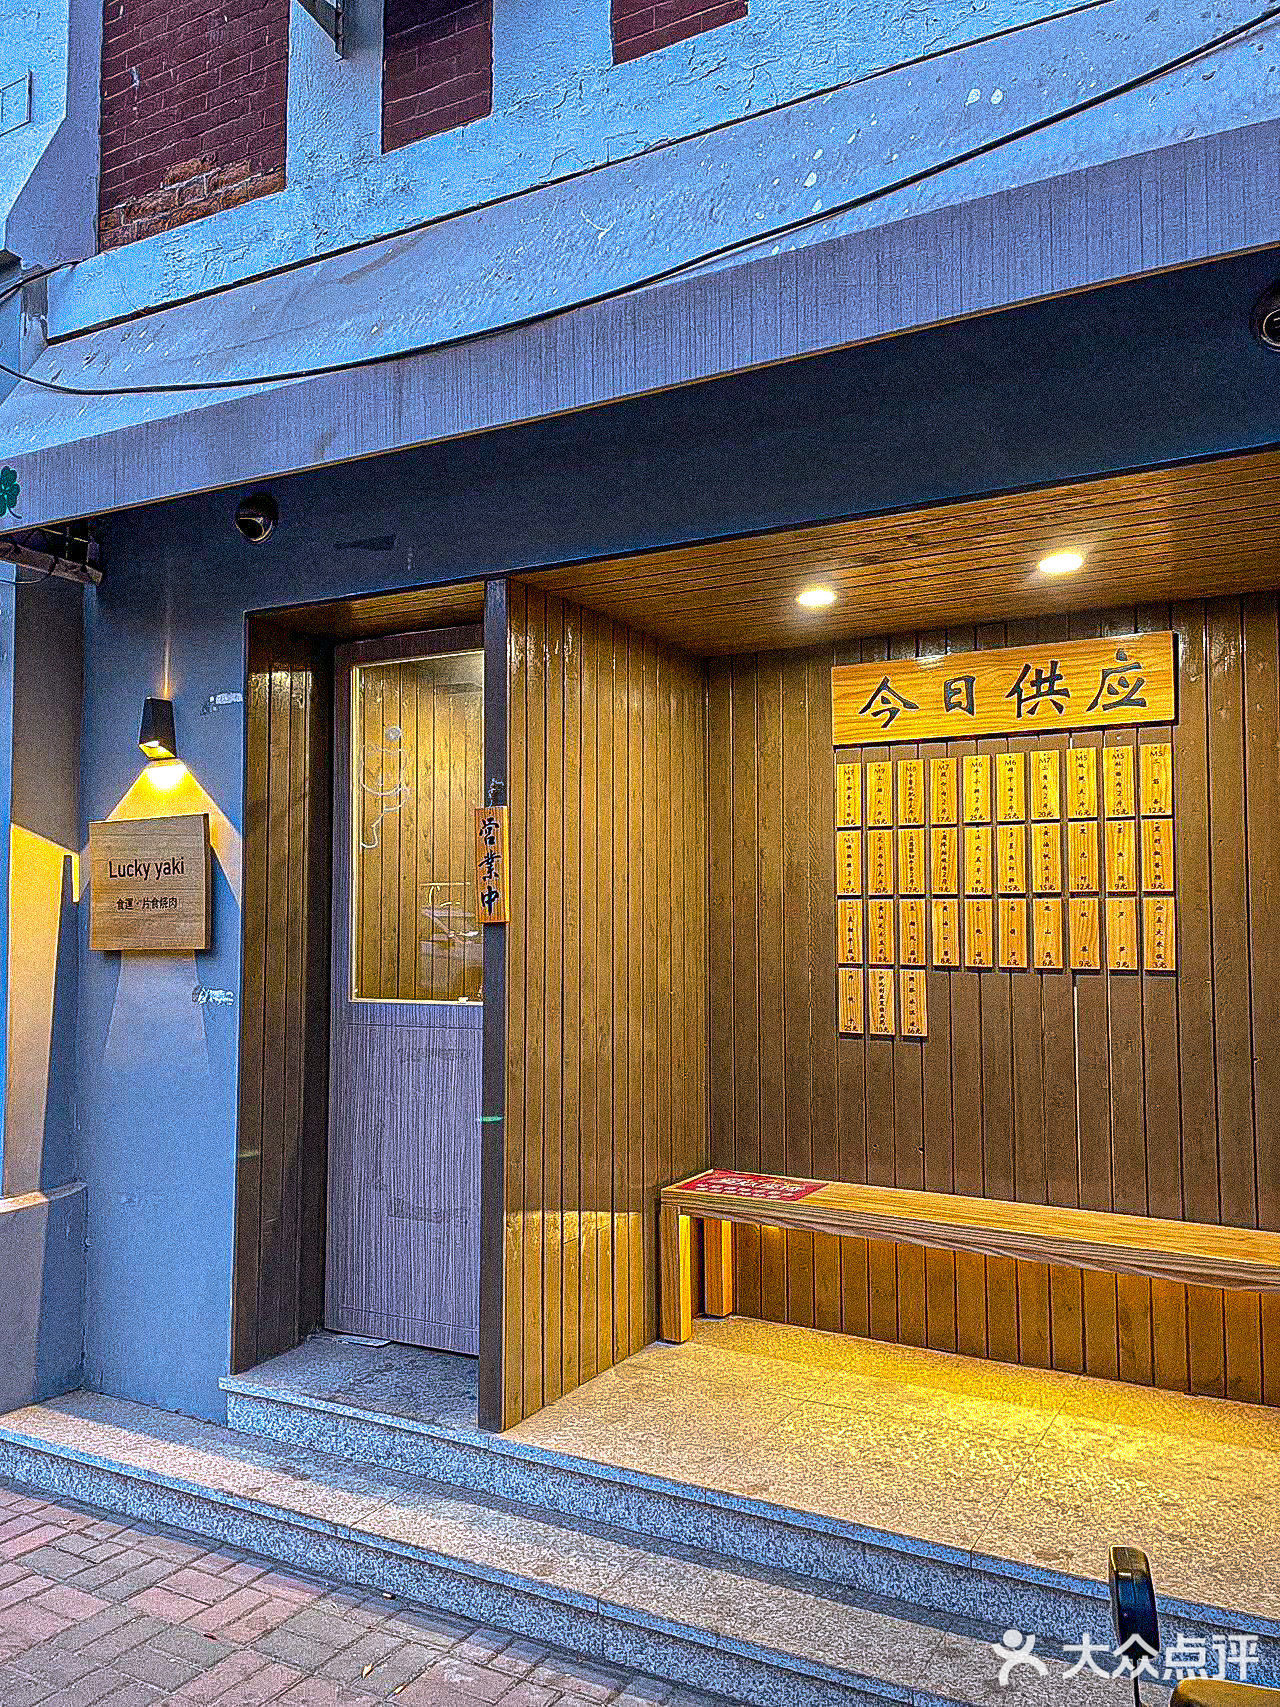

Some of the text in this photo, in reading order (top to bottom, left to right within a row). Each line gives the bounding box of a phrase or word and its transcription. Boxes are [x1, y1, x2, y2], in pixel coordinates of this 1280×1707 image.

[858, 648, 1147, 729] 今日供应
[109, 857, 184, 880] Lucky yaki
